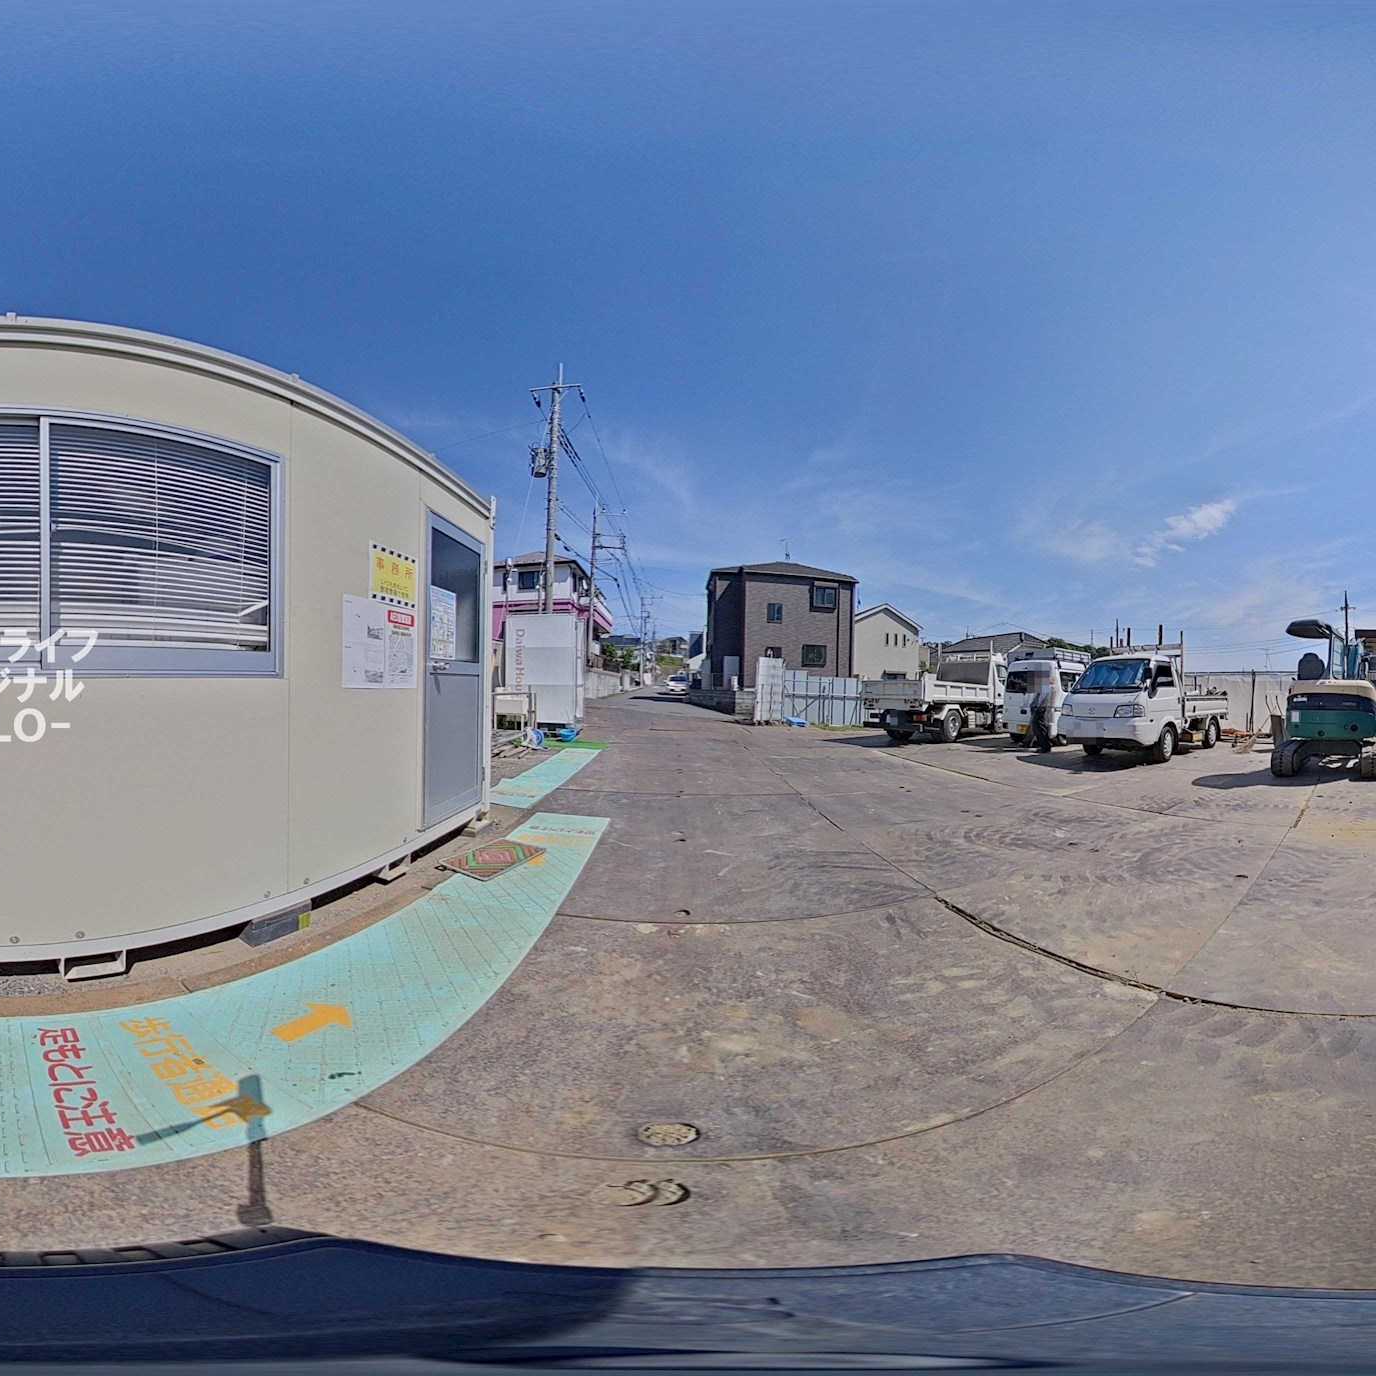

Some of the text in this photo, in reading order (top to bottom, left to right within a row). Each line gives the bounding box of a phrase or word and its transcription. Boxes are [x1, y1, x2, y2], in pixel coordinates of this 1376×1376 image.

[37, 1027, 136, 1157] 足もとに注意
